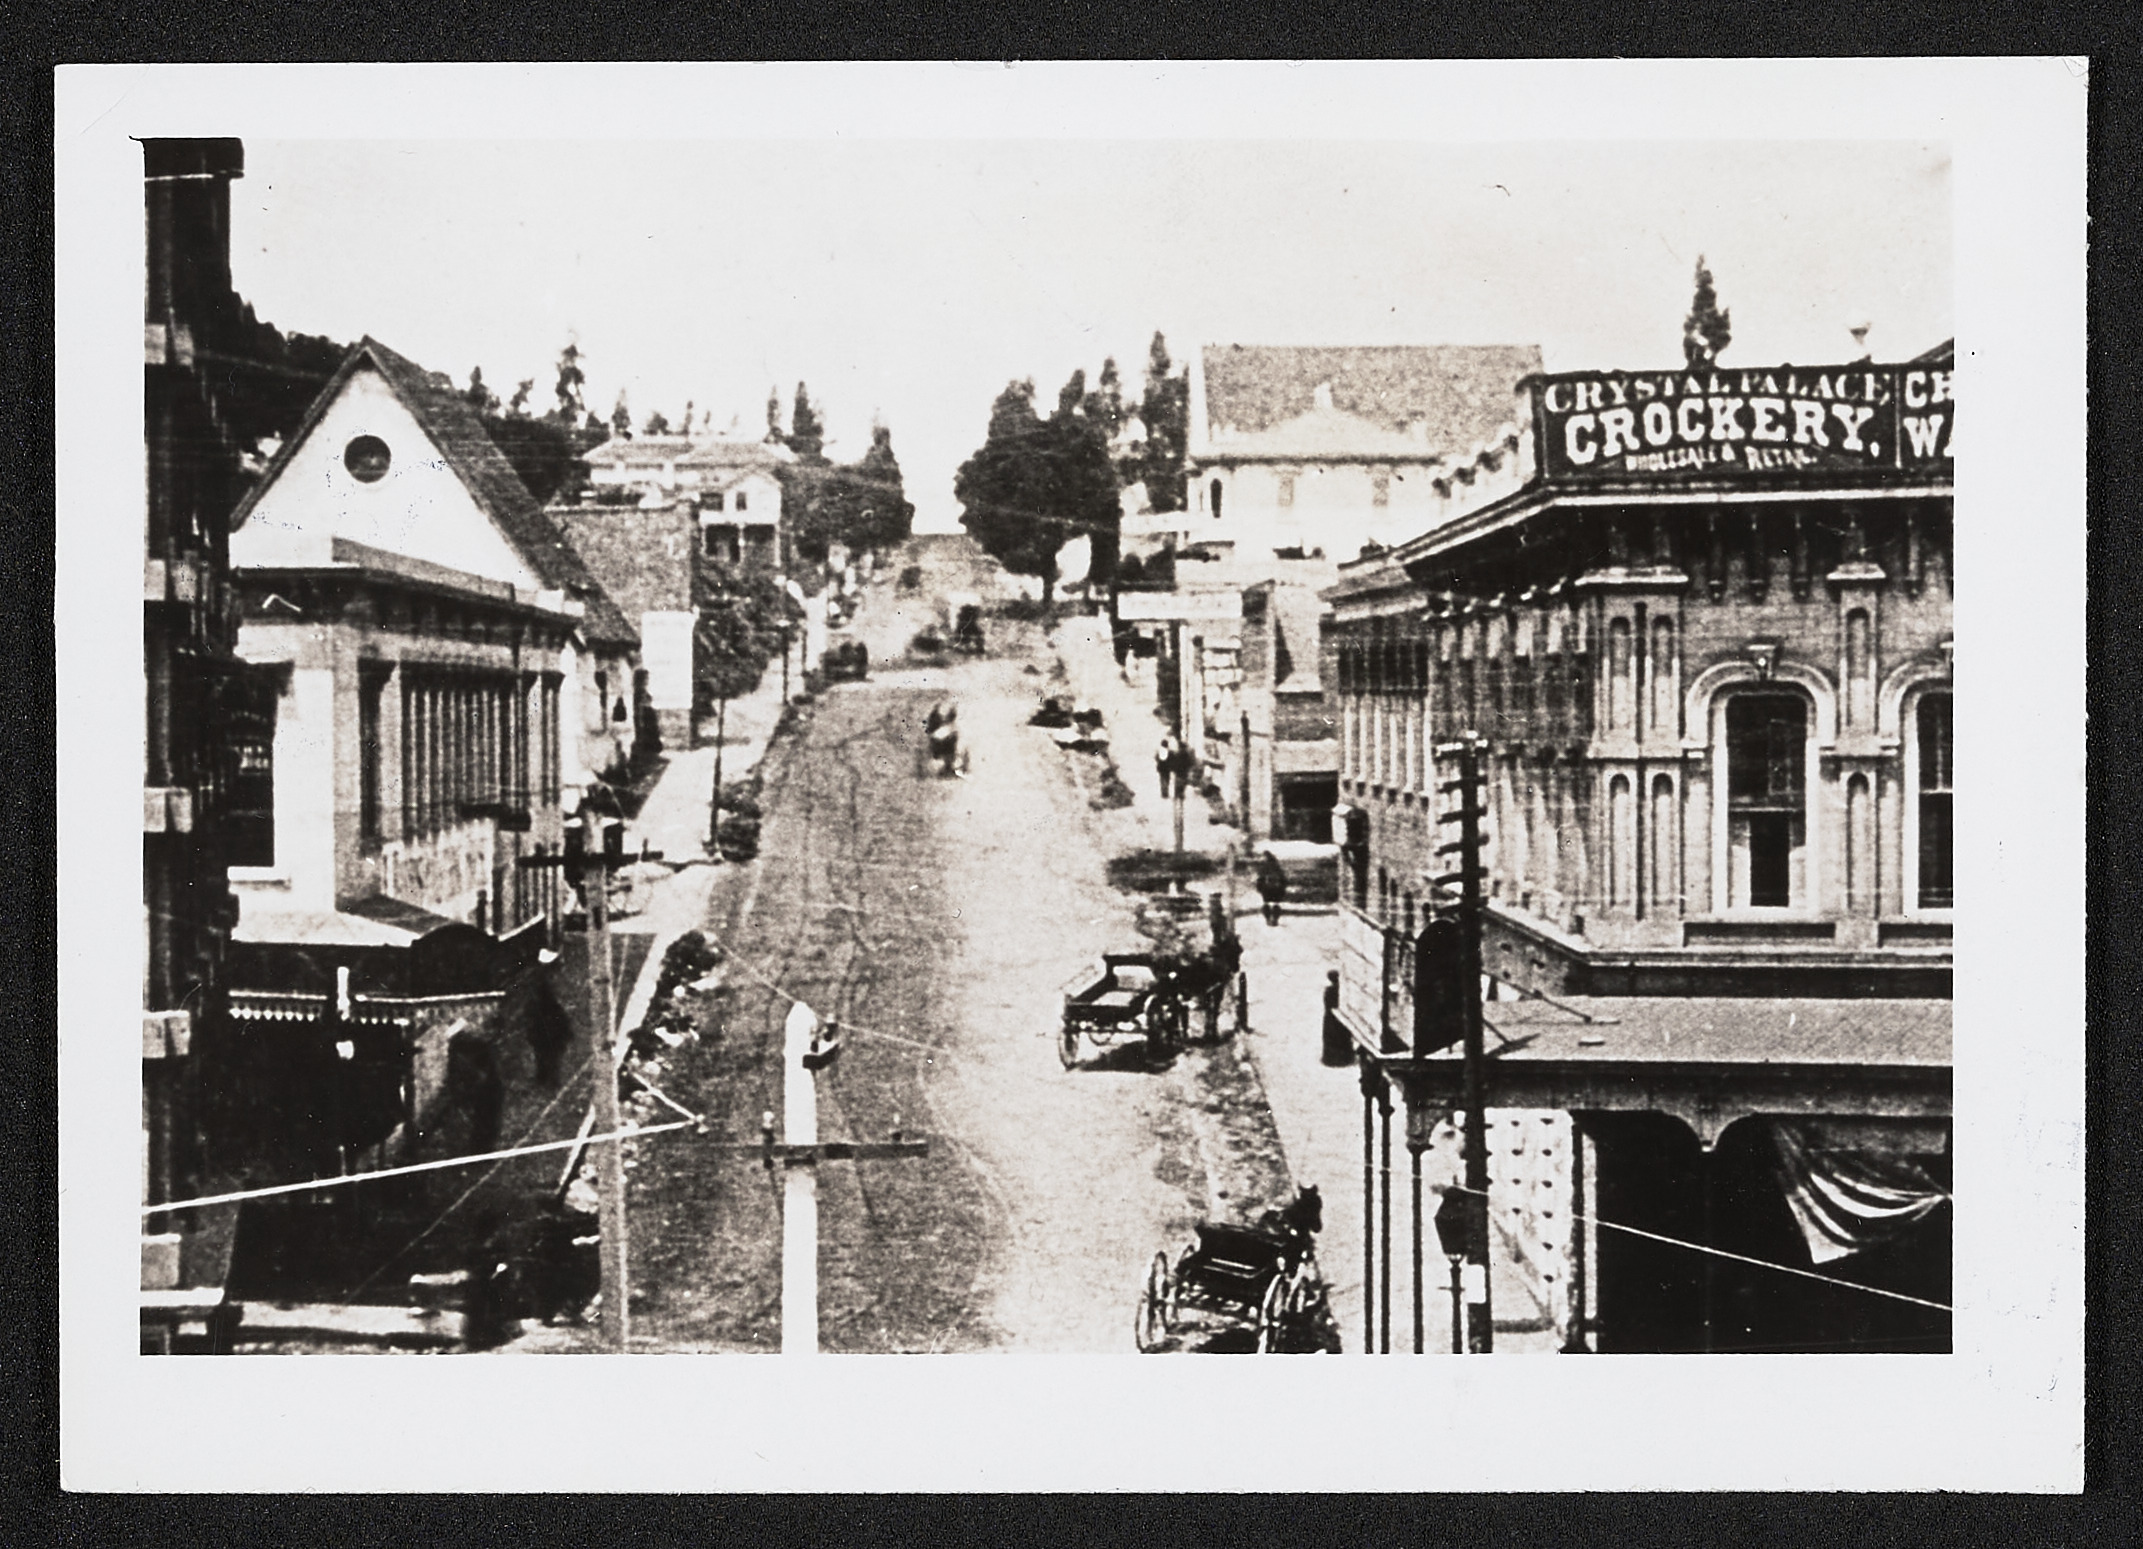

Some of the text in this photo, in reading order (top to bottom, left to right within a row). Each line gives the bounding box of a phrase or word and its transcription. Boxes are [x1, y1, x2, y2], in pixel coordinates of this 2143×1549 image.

[1545, 373, 1891, 412] CRYSTAL PALACE
[1565, 397, 1880, 465] CROCKERY.
